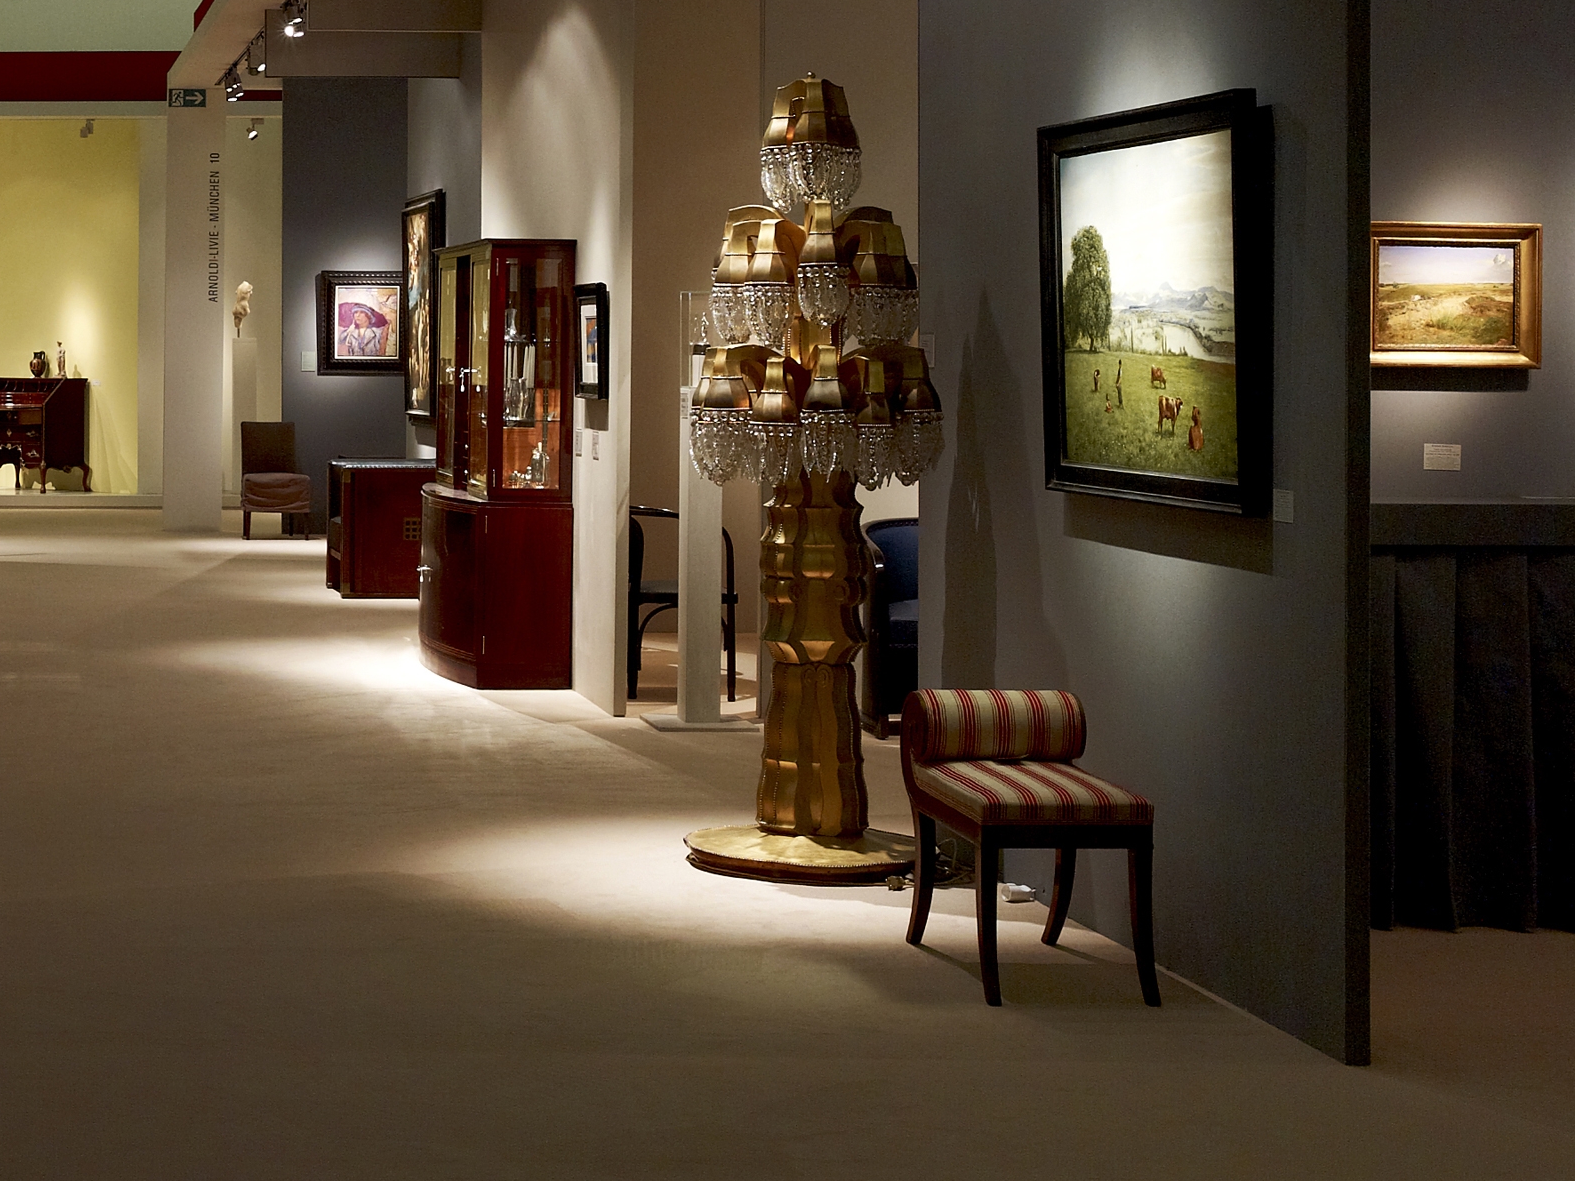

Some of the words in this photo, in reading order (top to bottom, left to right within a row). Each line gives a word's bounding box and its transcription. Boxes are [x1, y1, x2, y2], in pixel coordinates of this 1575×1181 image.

[209, 152, 220, 164] 10
[206, 171, 220, 222] MÜNCHEN
[208, 231, 219, 303] ARNOLDI-LIVIE
